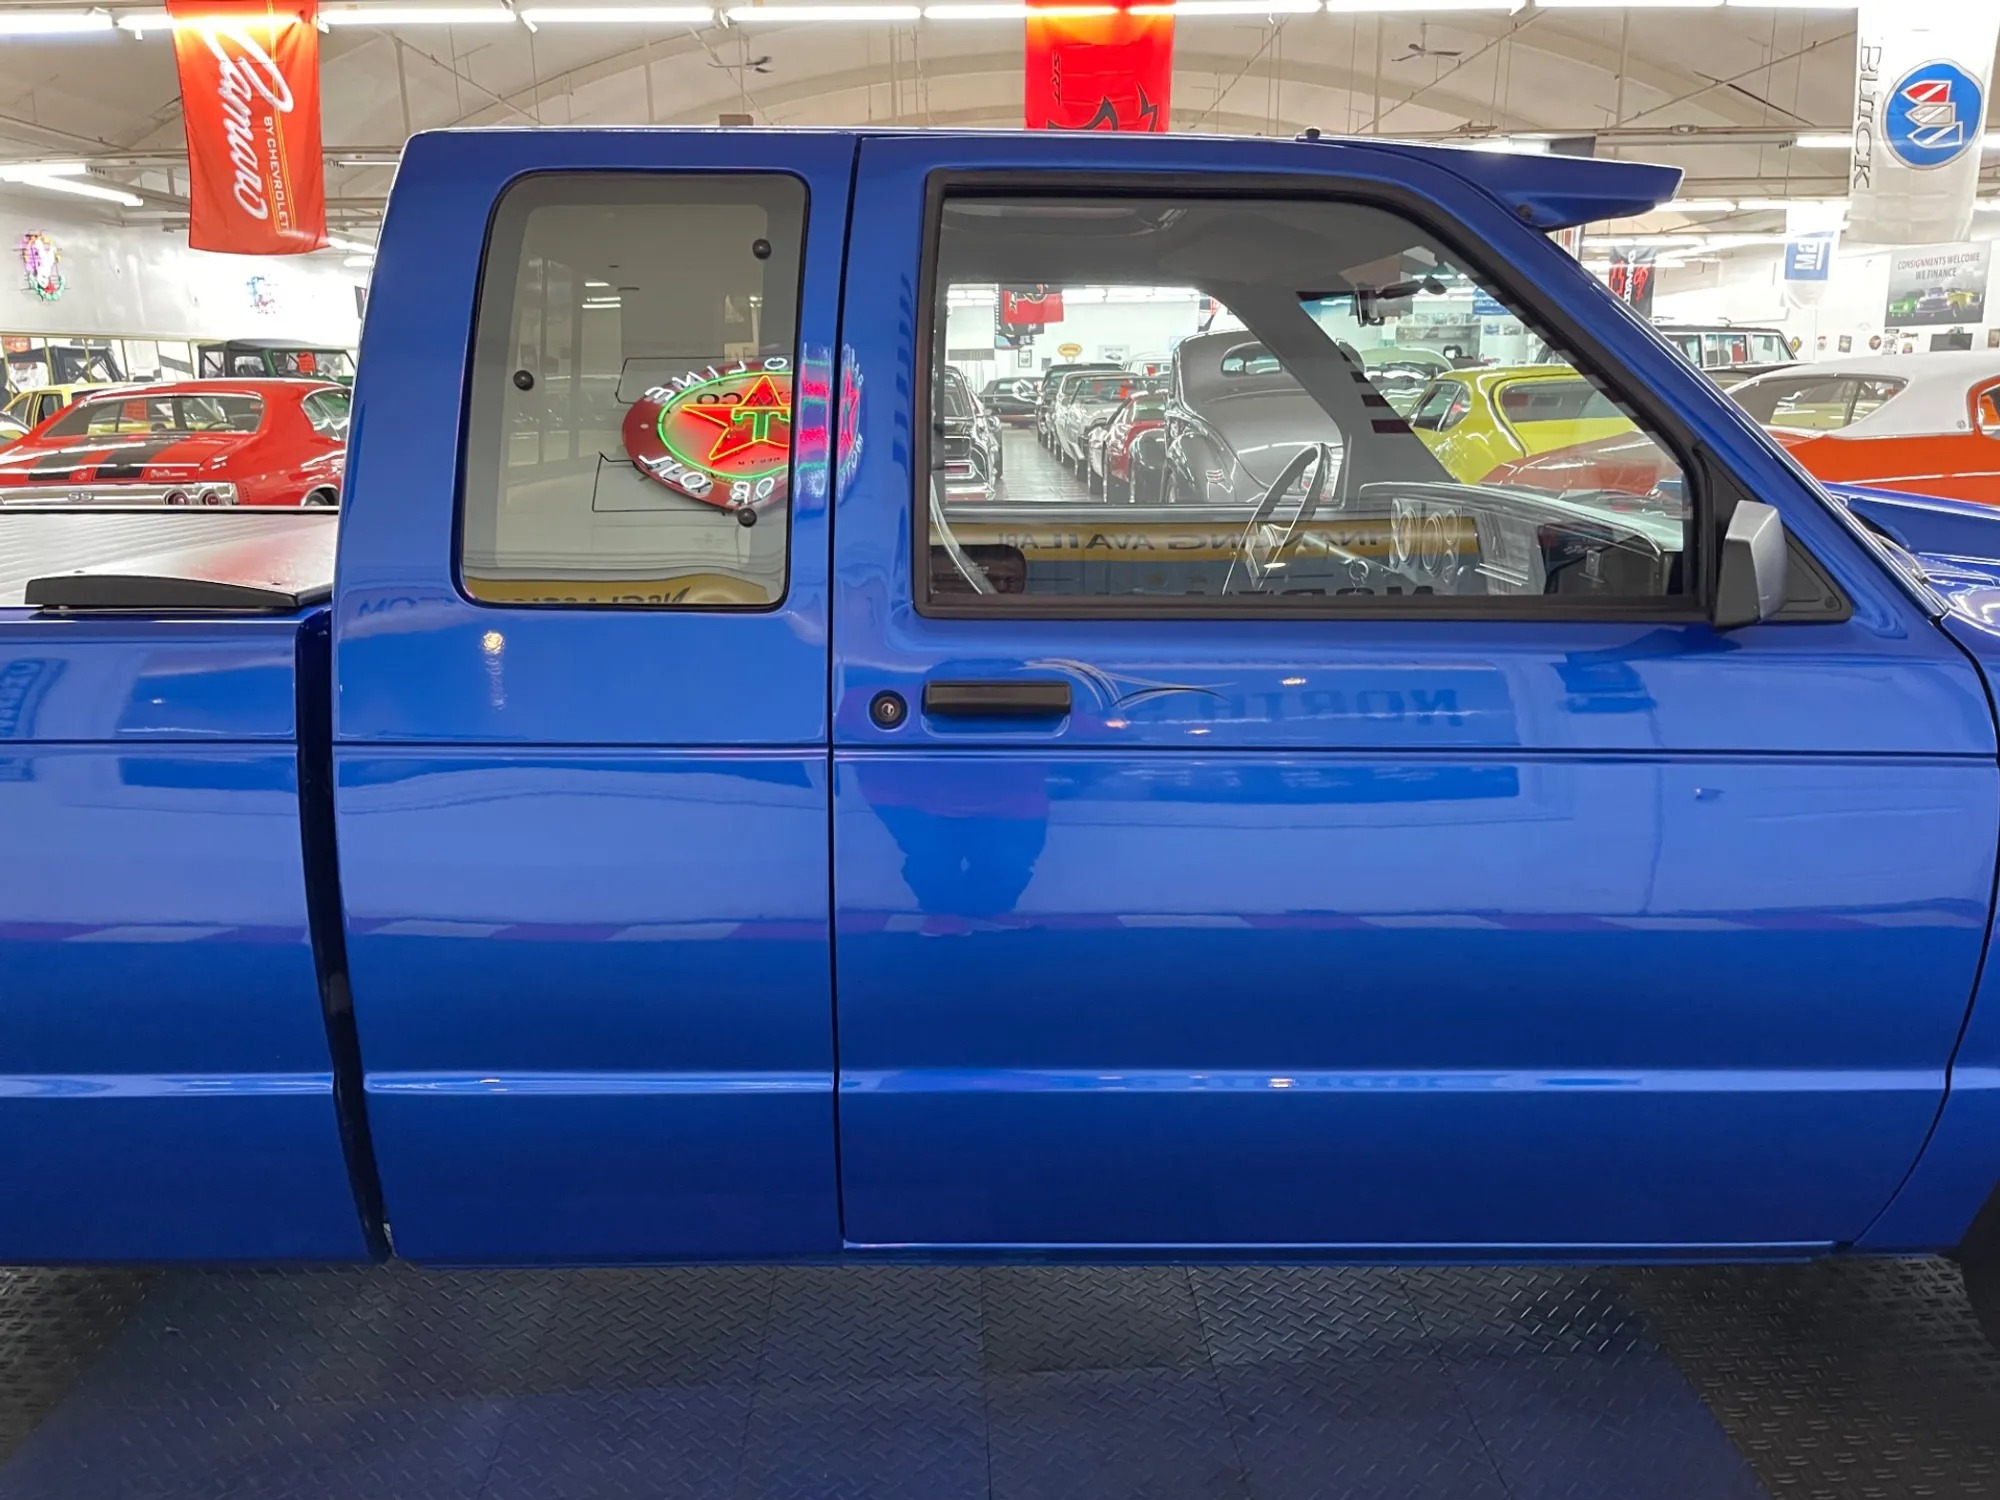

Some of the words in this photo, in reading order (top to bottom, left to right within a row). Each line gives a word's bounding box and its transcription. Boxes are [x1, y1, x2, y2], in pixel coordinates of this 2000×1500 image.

[199, 22, 295, 220] Camaro
[263, 115, 275, 135] BY
[1853, 44, 1882, 189] BUICK
[266, 137, 290, 230] CHEVROLET
[1897, 256, 1946, 270] CONSIGNMENTS
[1947, 252, 1981, 264] WELCOME
[1915, 271, 1926, 280] WE
[1926, 267, 1957, 279] FINANCE
